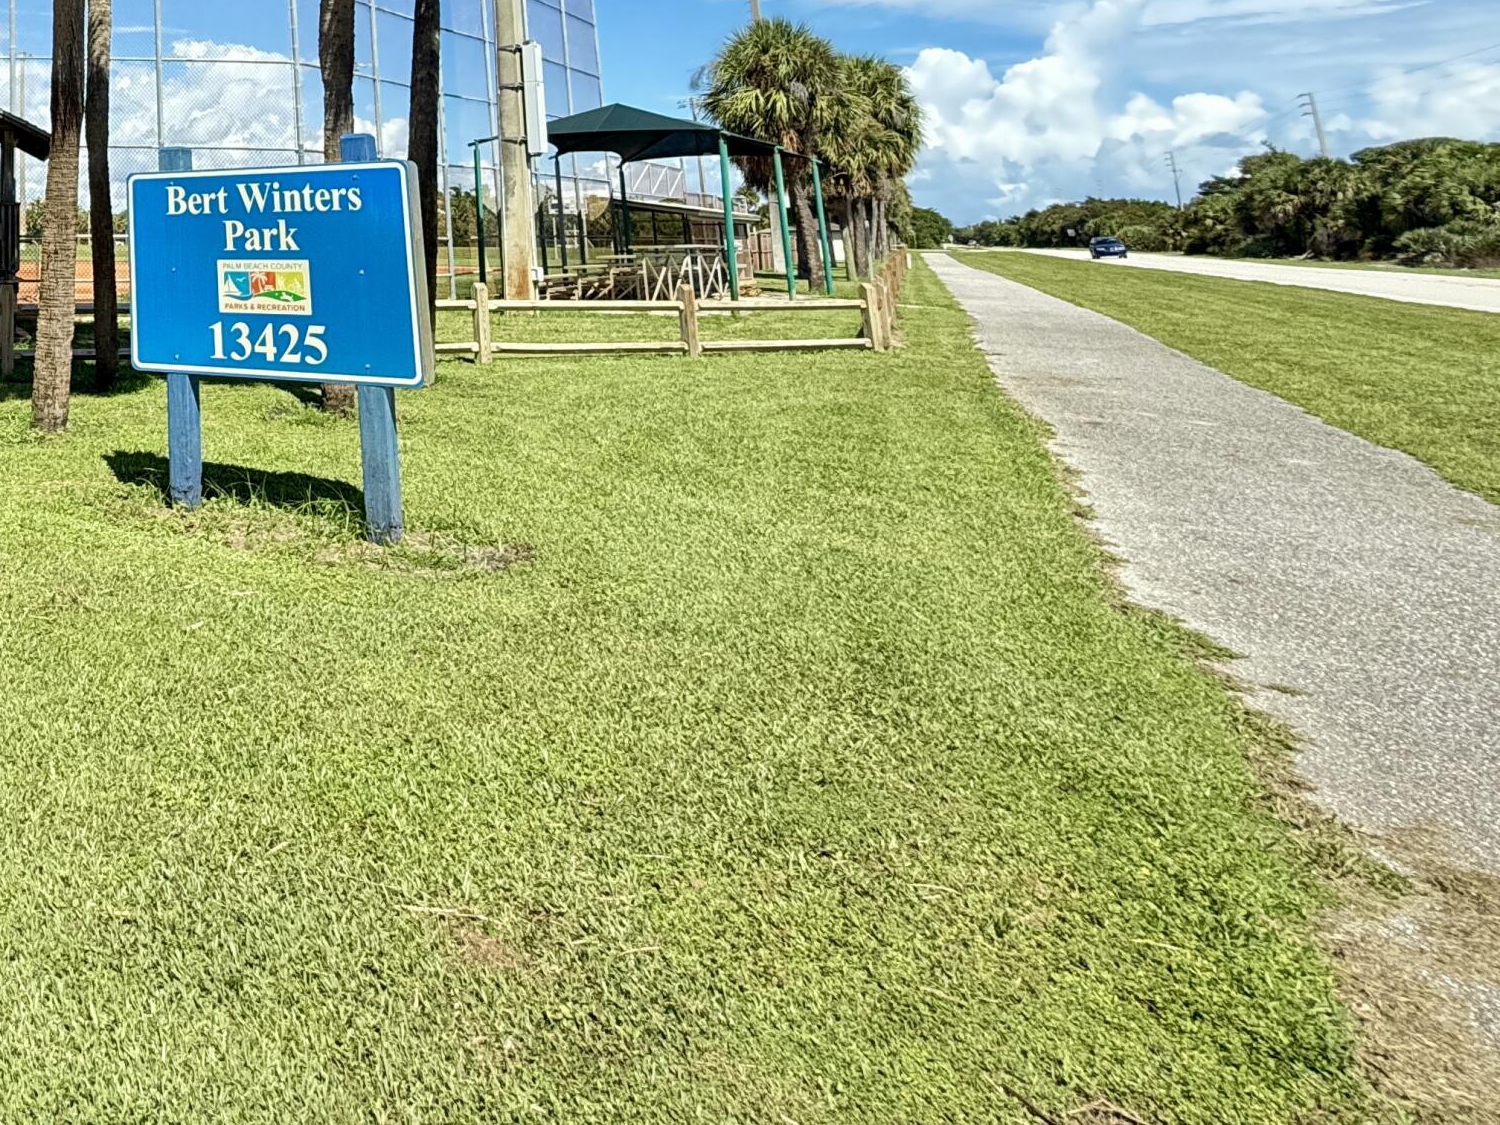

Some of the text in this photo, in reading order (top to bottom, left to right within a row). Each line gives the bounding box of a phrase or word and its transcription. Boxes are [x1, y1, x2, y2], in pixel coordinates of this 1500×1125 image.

[165, 181, 362, 215] Bert Winters
[222, 219, 300, 251] Park
[223, 262, 302, 270] PALM BEACH COUNTY
[224, 303, 306, 312] PARKS & RECREATION
[209, 321, 328, 365] 13425
